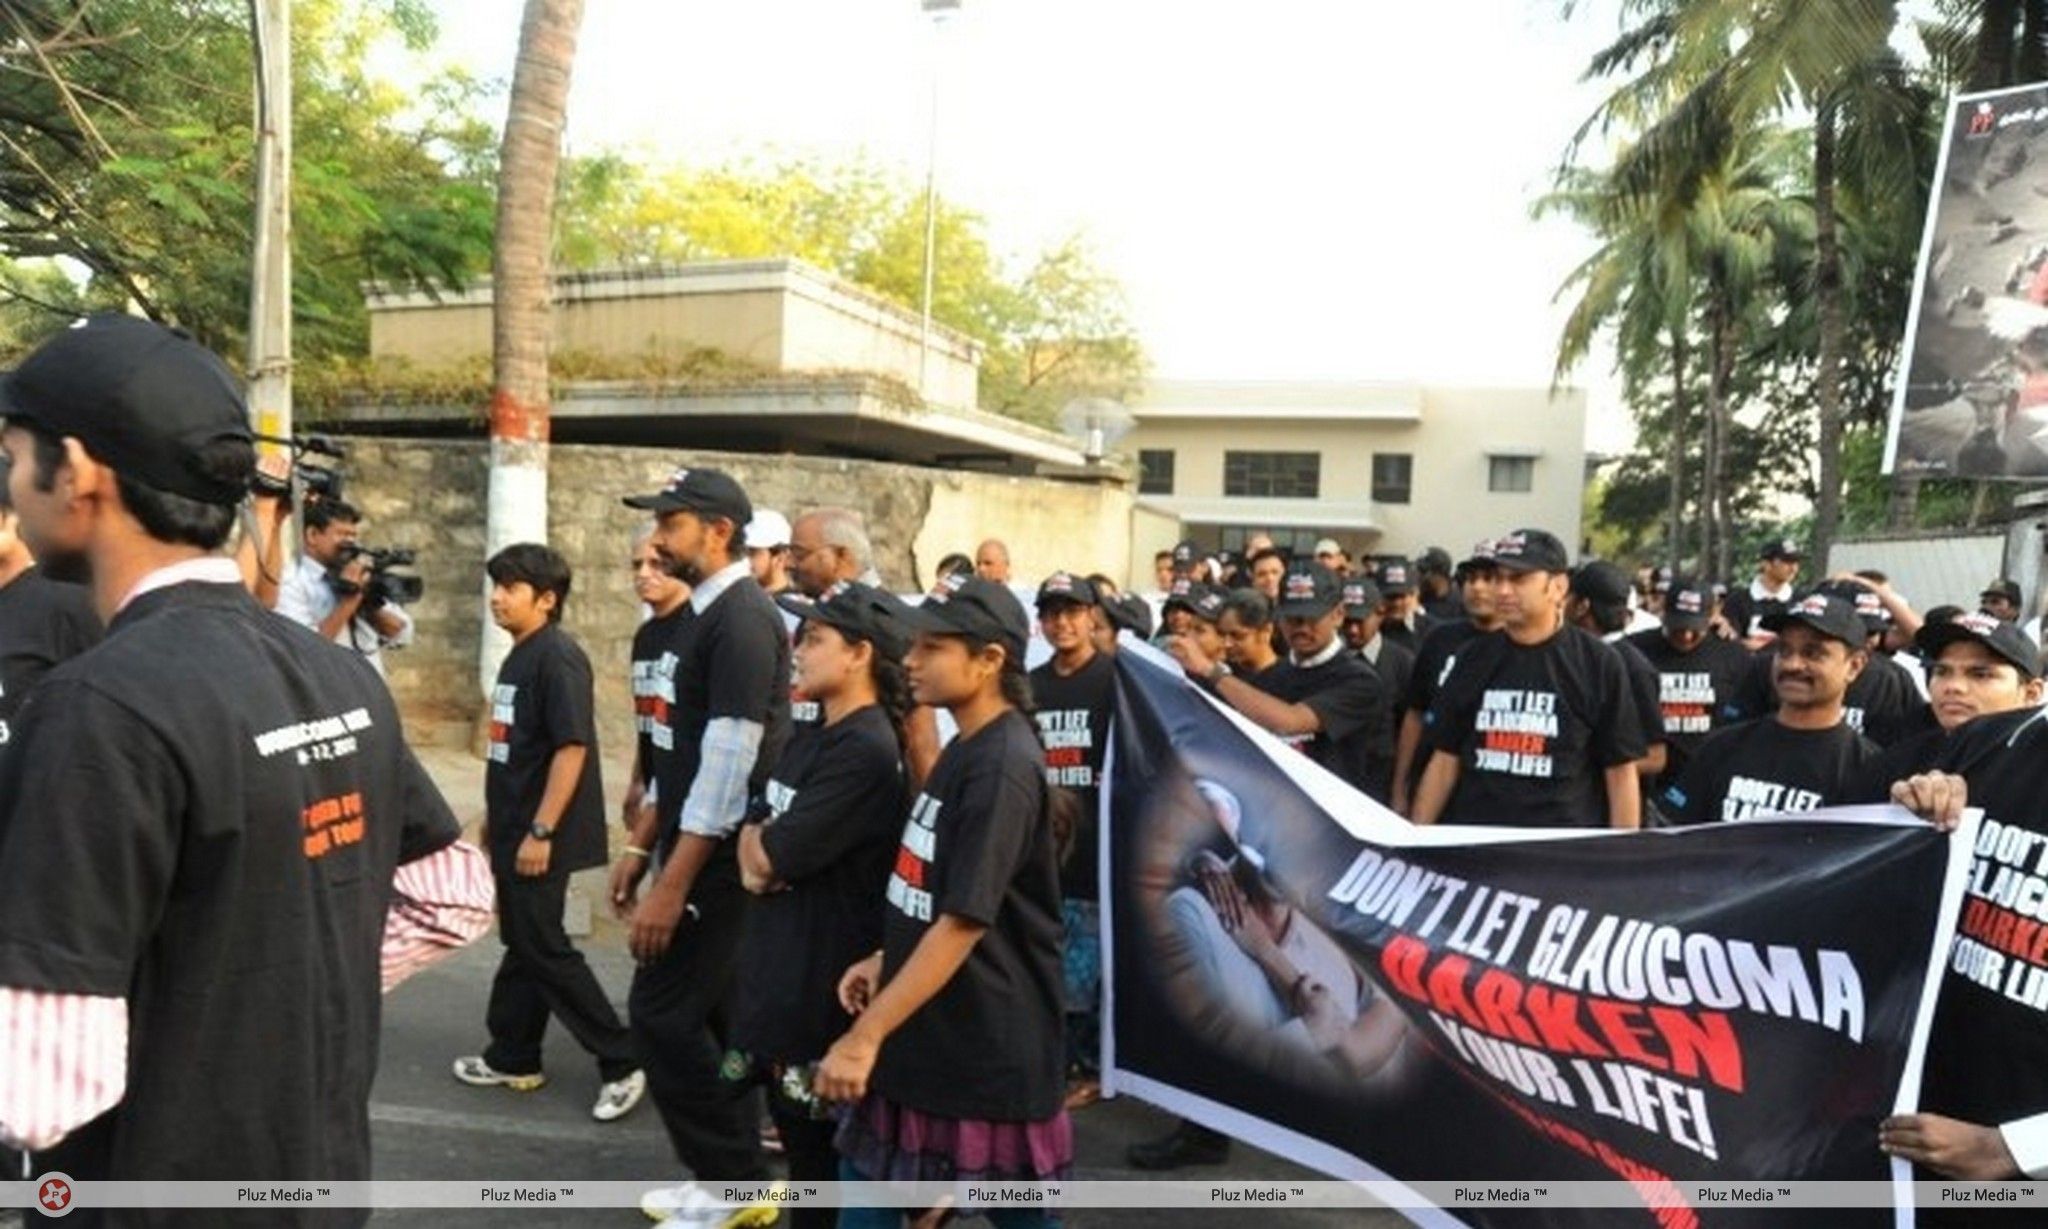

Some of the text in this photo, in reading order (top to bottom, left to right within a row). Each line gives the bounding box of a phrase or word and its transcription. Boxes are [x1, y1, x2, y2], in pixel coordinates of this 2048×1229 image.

[1525, 691, 1555, 714] LET
[1784, 788, 1823, 813] LET
[1328, 849, 1865, 1044] DON'T LET GLAUCOMA
[1381, 934, 1743, 1093] DARKEN
[1428, 1010, 1718, 1160] YOUR LIFE!
